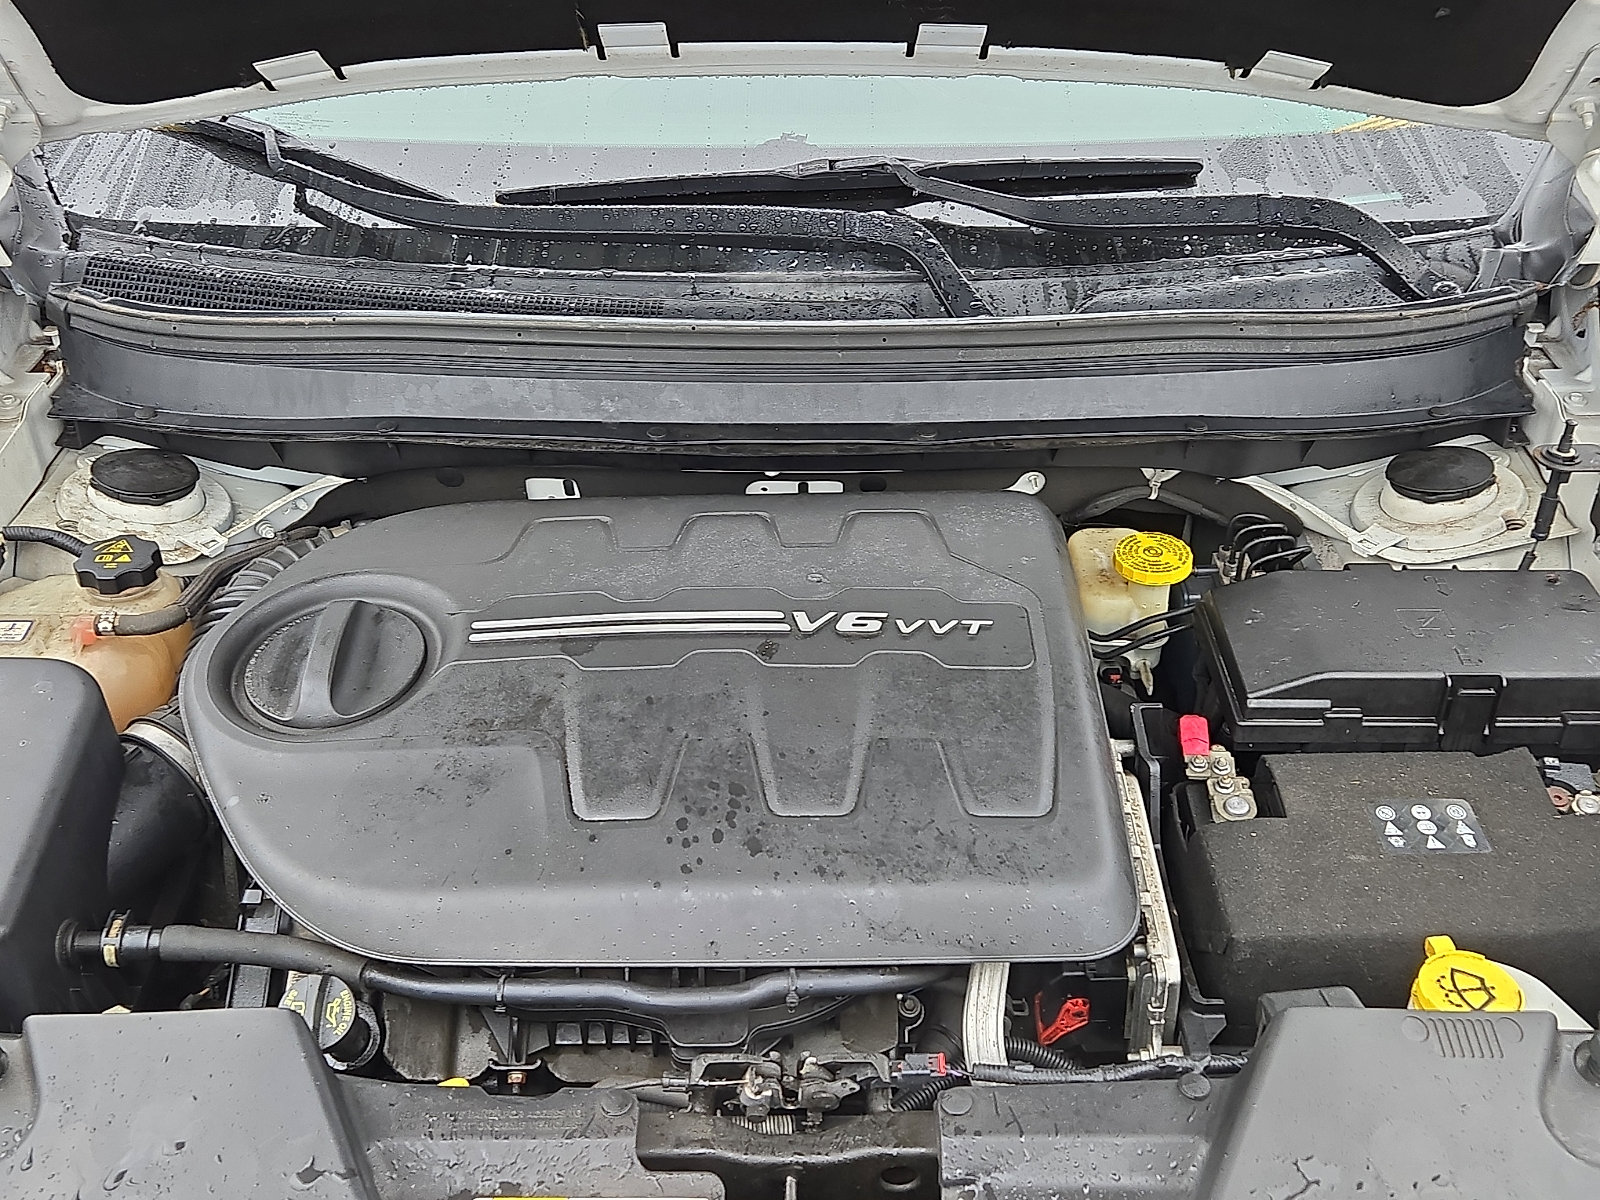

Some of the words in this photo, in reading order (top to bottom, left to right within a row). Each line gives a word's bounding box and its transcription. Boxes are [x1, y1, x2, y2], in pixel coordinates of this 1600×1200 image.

[791, 611, 889, 634] V6
[895, 619, 994, 635] VVT
[340, 990, 351, 1022] ENGINE
[333, 1022, 348, 1036] OIL
